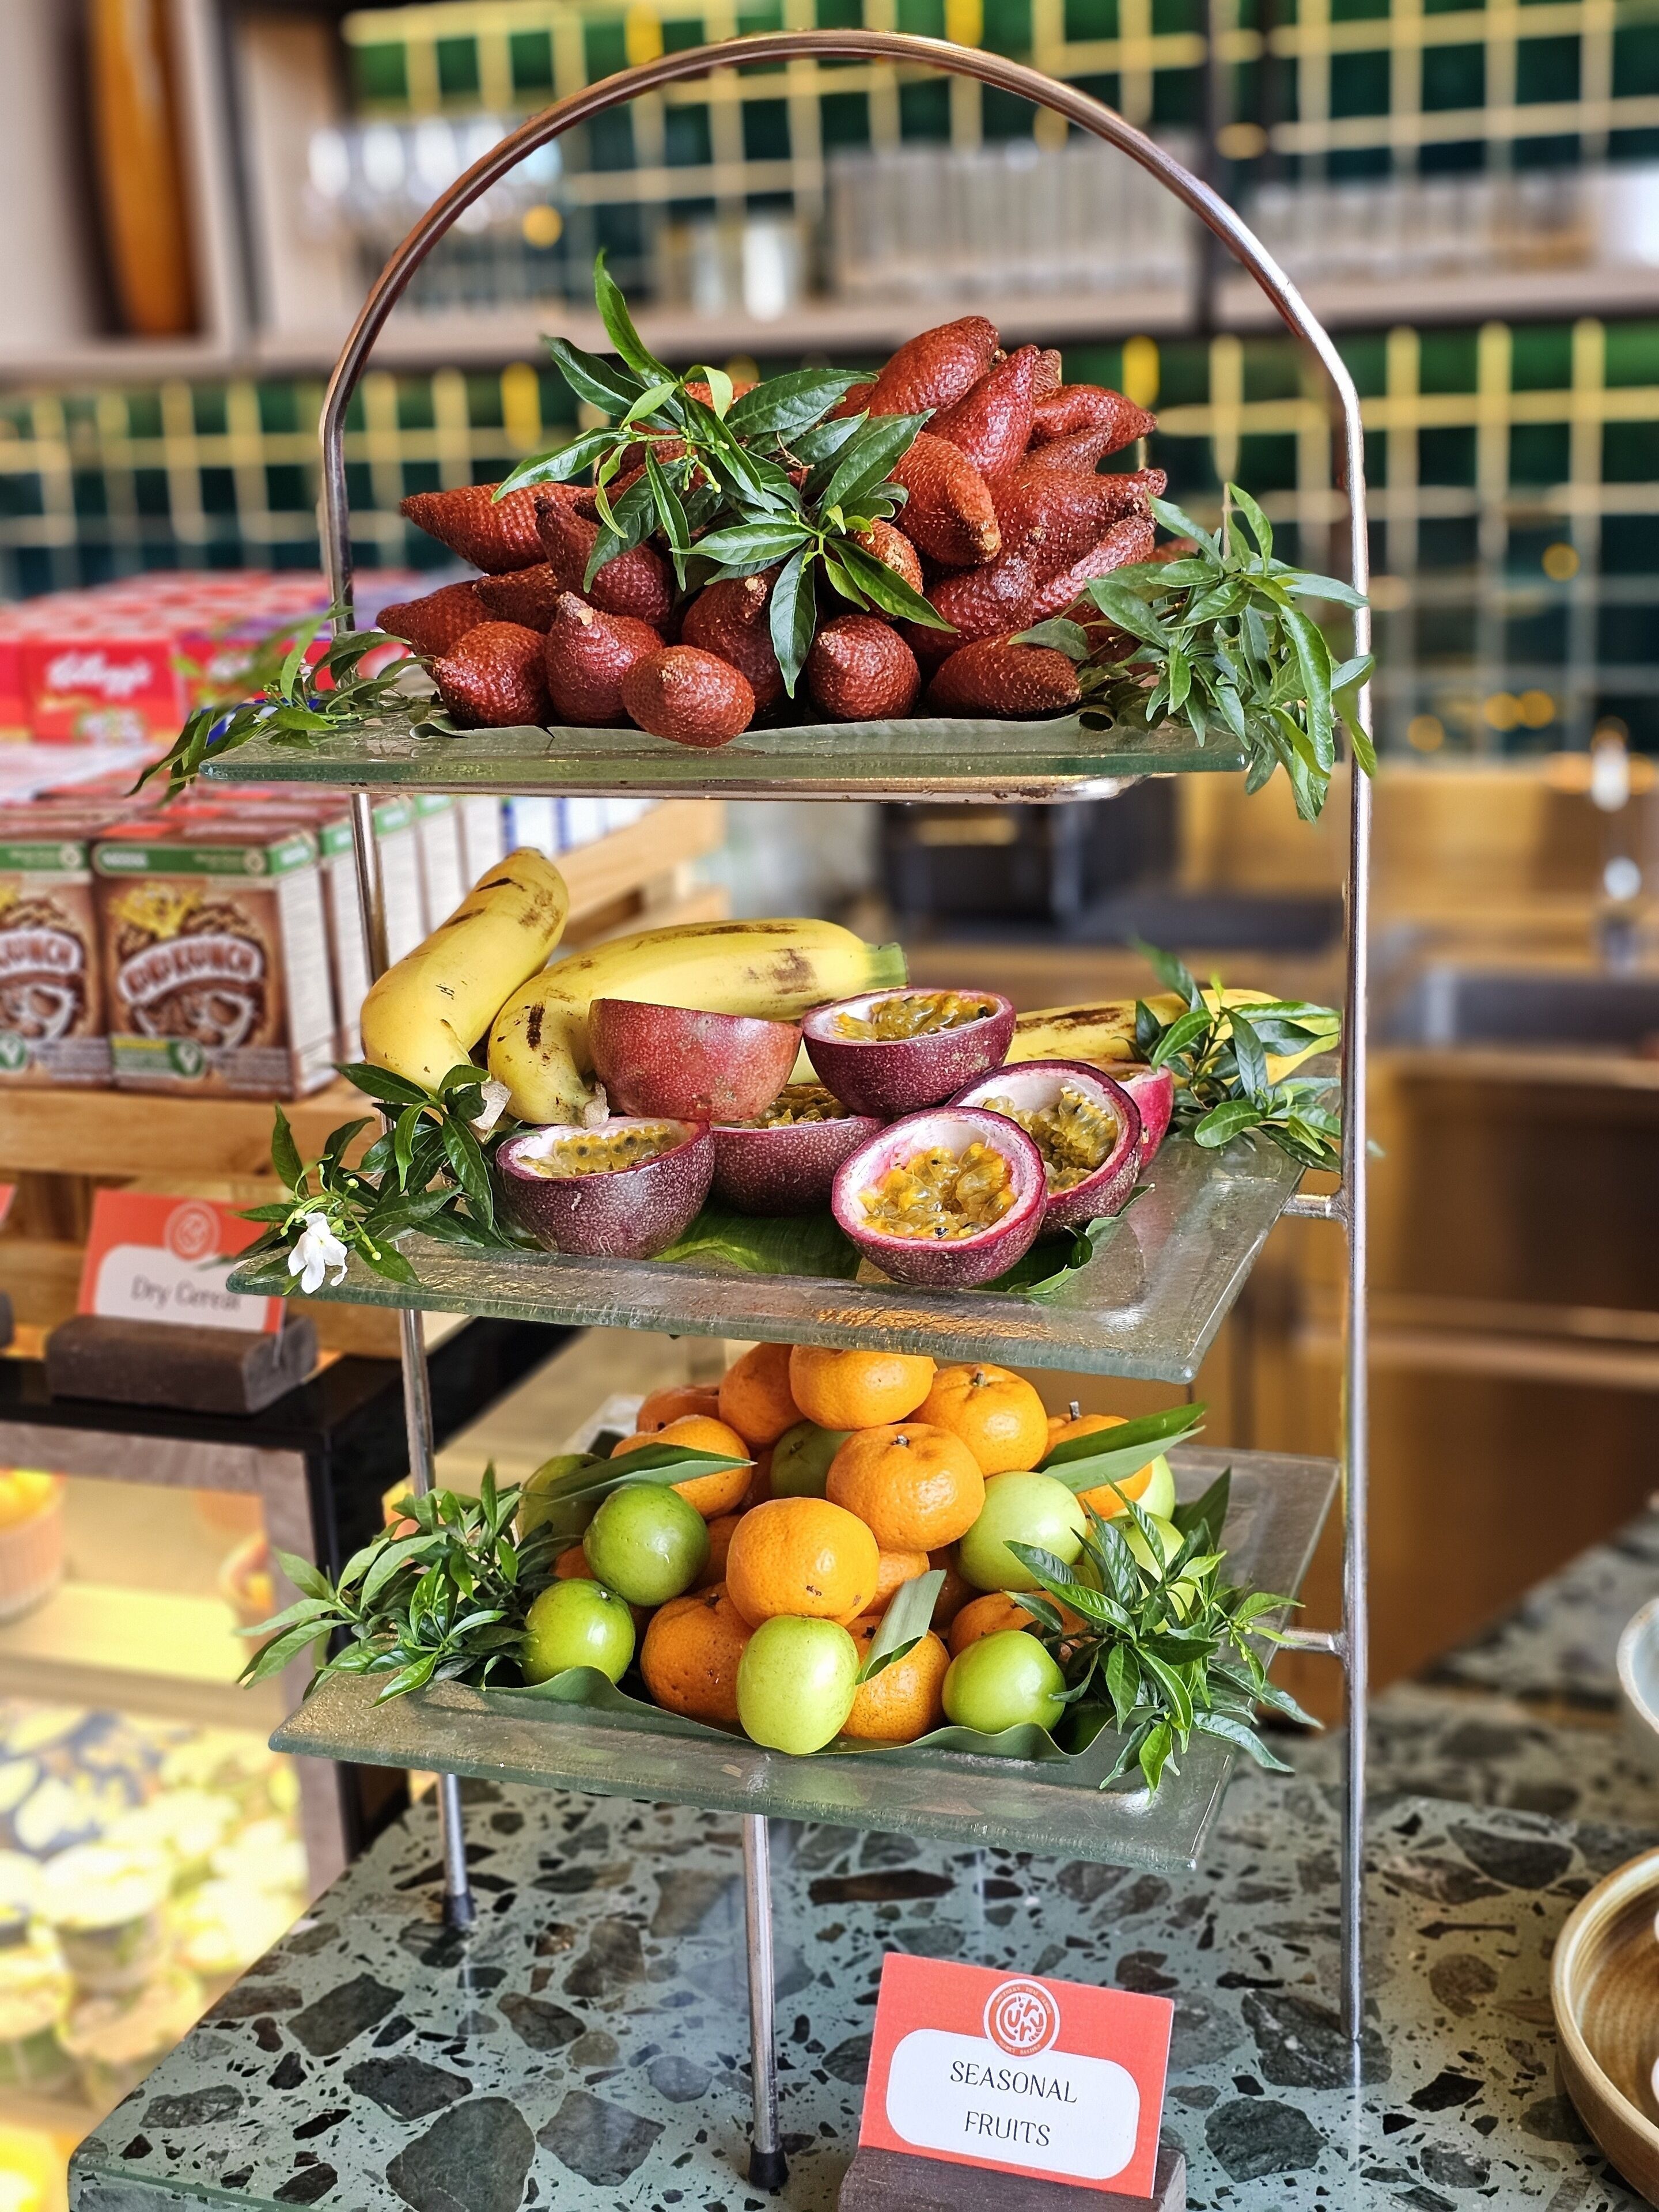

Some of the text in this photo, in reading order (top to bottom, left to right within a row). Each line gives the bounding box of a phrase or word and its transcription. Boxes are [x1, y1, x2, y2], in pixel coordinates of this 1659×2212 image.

[131, 1274, 170, 1311] Dry
[950, 2061, 1078, 2104] SEASONAL
[964, 2111, 1051, 2147] FRUITS
